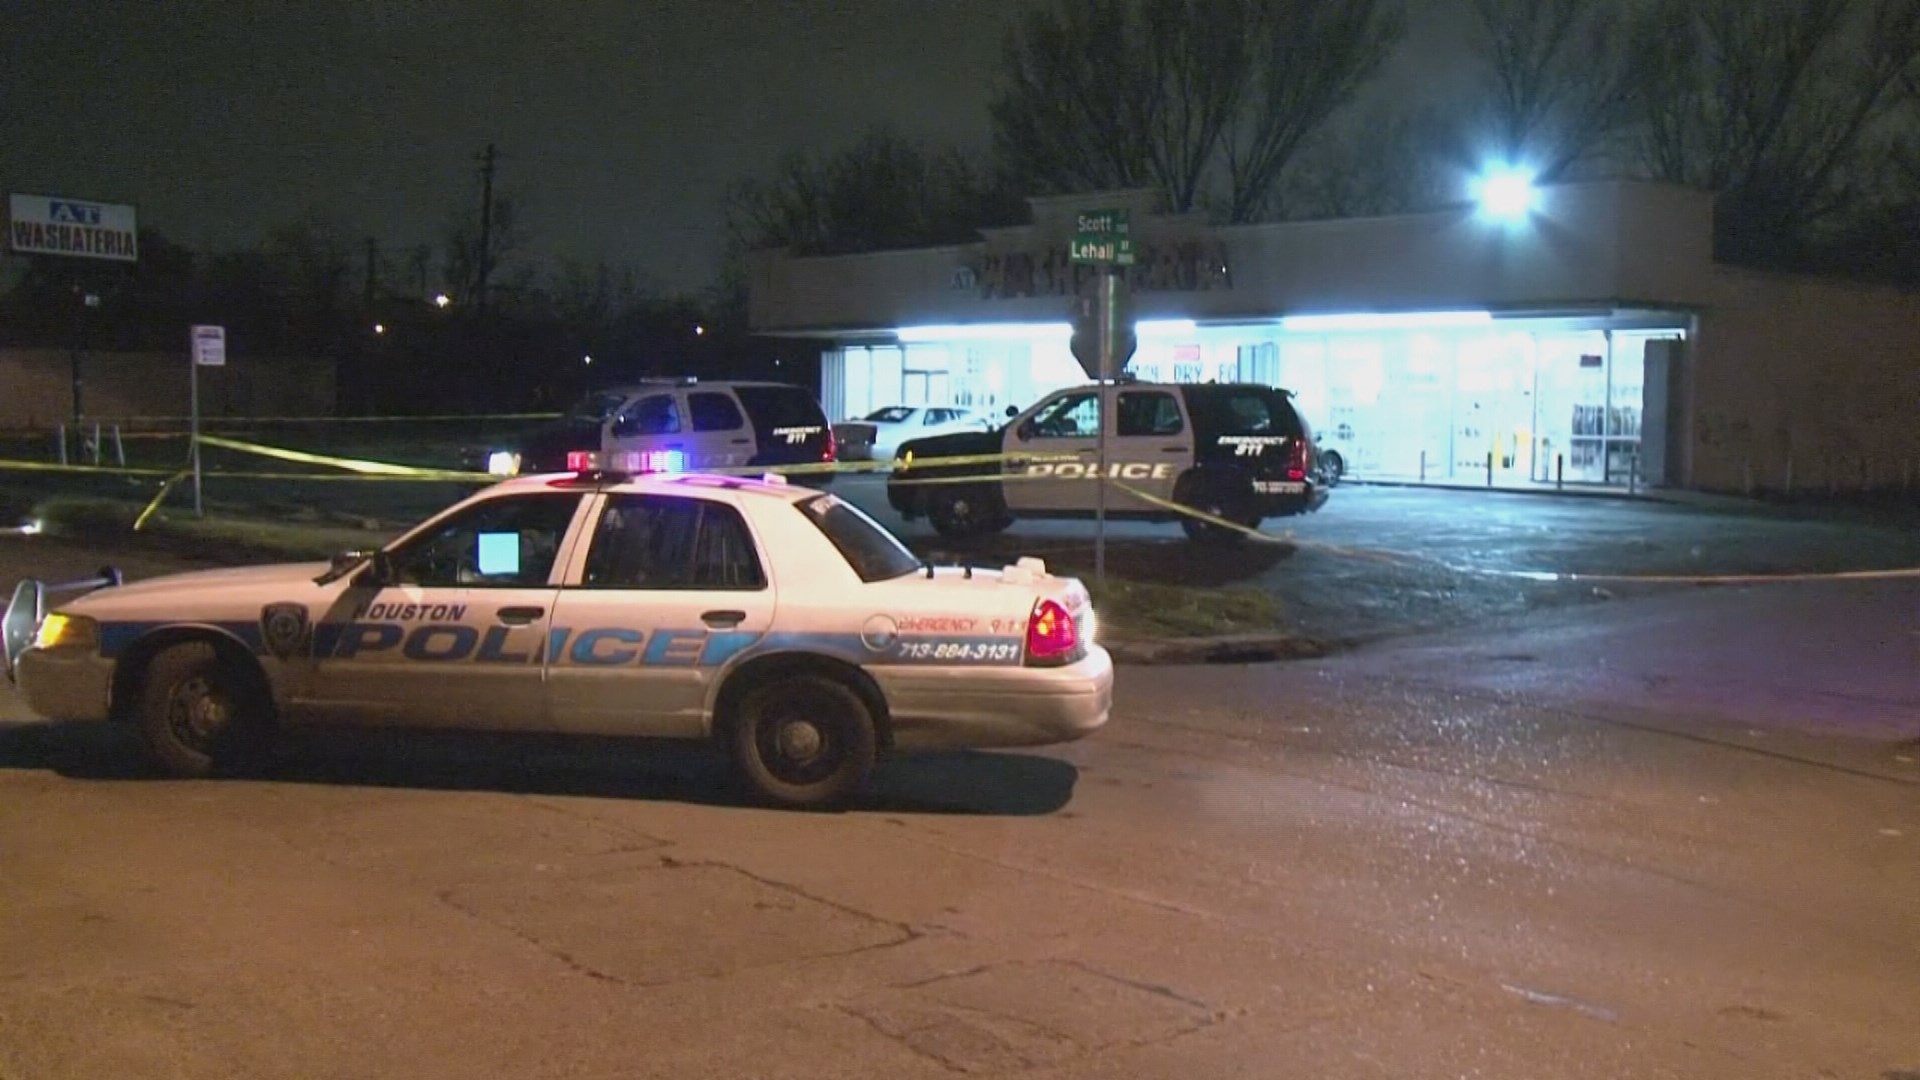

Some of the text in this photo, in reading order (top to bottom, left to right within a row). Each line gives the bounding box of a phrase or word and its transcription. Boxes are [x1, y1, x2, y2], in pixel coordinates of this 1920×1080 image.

[52, 204, 100, 223] AT
[1078, 215, 1112, 233] Scott
[14, 221, 134, 256] WASHATERIA
[1071, 240, 1114, 260] Lehall
[1234, 443, 1264, 456] 911
[1027, 462, 1176, 479] POLICE
[352, 603, 467, 621] HOUSTON
[899, 617, 979, 632] EMERGENCY
[333, 622, 706, 668] POLICE
[898, 643, 1019, 660] 713-884-3131
